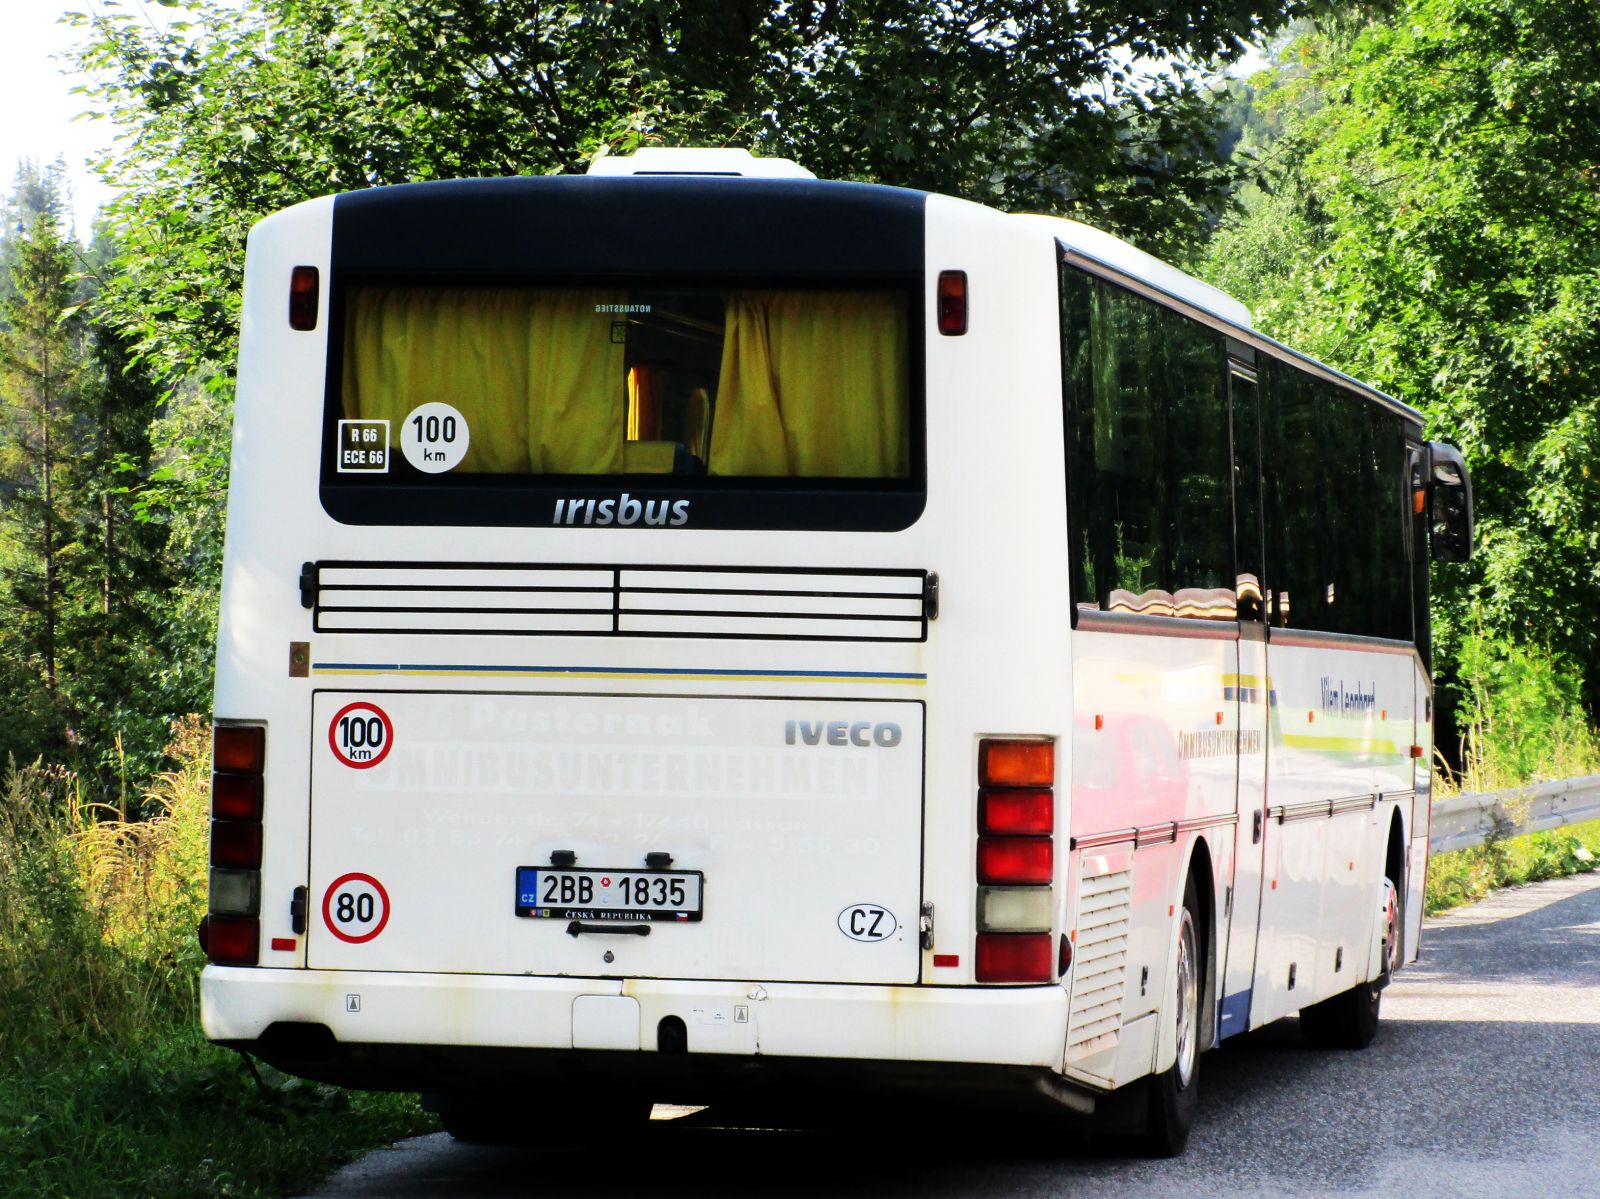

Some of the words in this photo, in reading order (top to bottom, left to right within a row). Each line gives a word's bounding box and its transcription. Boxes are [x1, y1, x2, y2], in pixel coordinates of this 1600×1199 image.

[351, 428, 360, 442] R
[362, 428, 378, 442] 66
[412, 415, 457, 443] 100
[343, 450, 366, 464] ECE
[369, 450, 384, 464] 66
[423, 448, 446, 462] km
[552, 493, 691, 526] irisbus
[339, 716, 384, 748] 100
[784, 719, 903, 748] IVECO
[349, 746, 372, 760] km
[521, 893, 535, 903] CZ
[542, 874, 594, 904] 2BB
[618, 877, 686, 906] 1835
[336, 892, 374, 923] 80
[565, 910, 595, 919] ČESKÁ
[600, 911, 652, 920] REPUBLIKA
[850, 908, 885, 938] CZ
